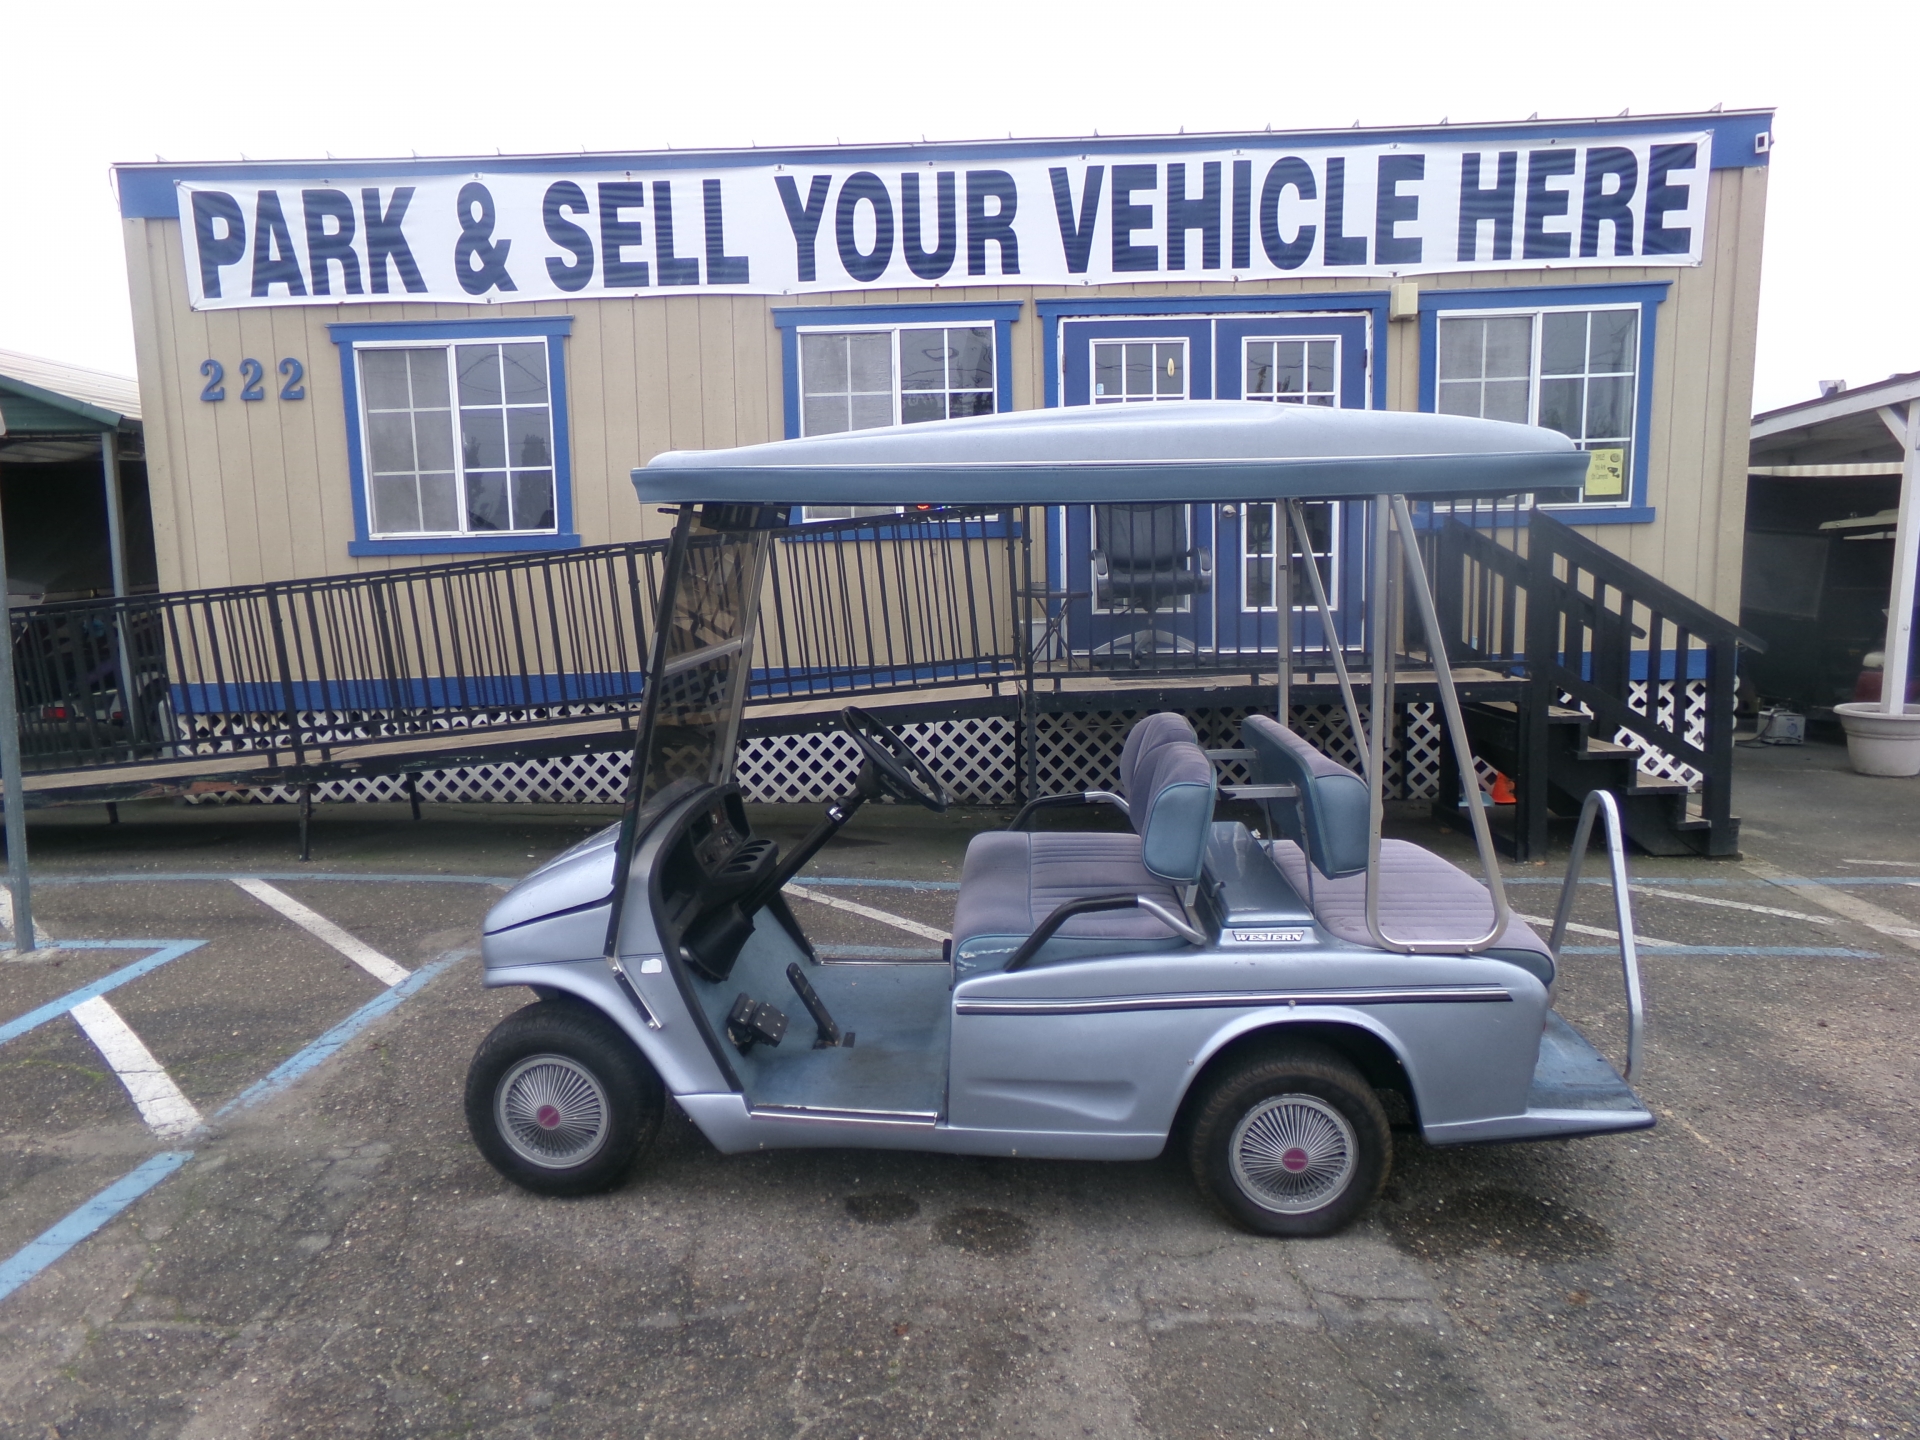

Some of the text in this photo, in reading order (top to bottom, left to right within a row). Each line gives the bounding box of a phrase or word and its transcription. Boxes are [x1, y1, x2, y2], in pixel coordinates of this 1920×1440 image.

[191, 141, 1698, 299] PARK & SELL YOUR VEHICLE HERE
[201, 358, 304, 401] 222
[1232, 930, 1304, 942] WESTERN
